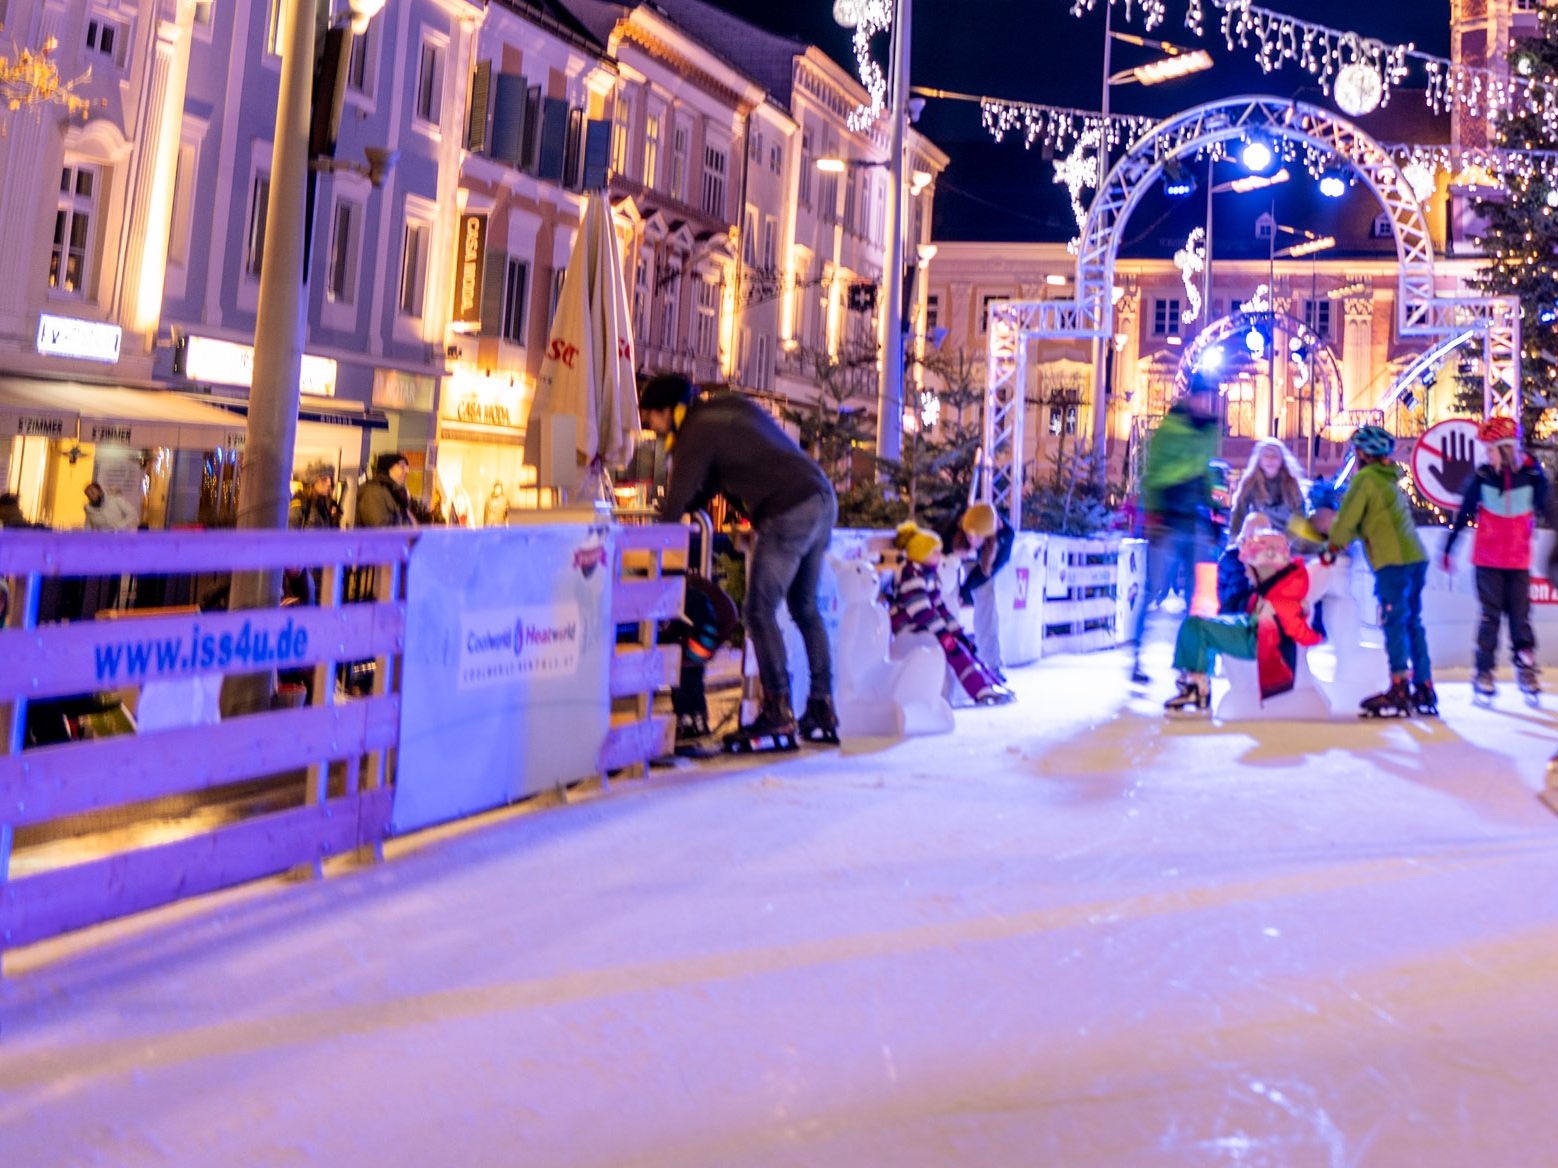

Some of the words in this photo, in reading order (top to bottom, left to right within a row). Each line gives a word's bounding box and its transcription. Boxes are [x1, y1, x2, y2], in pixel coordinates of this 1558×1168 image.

[464, 217, 480, 262] CASA
[457, 400, 482, 422] CASA
[484, 402, 510, 426] MODA
[95, 616, 309, 681] www.iss4u.de
